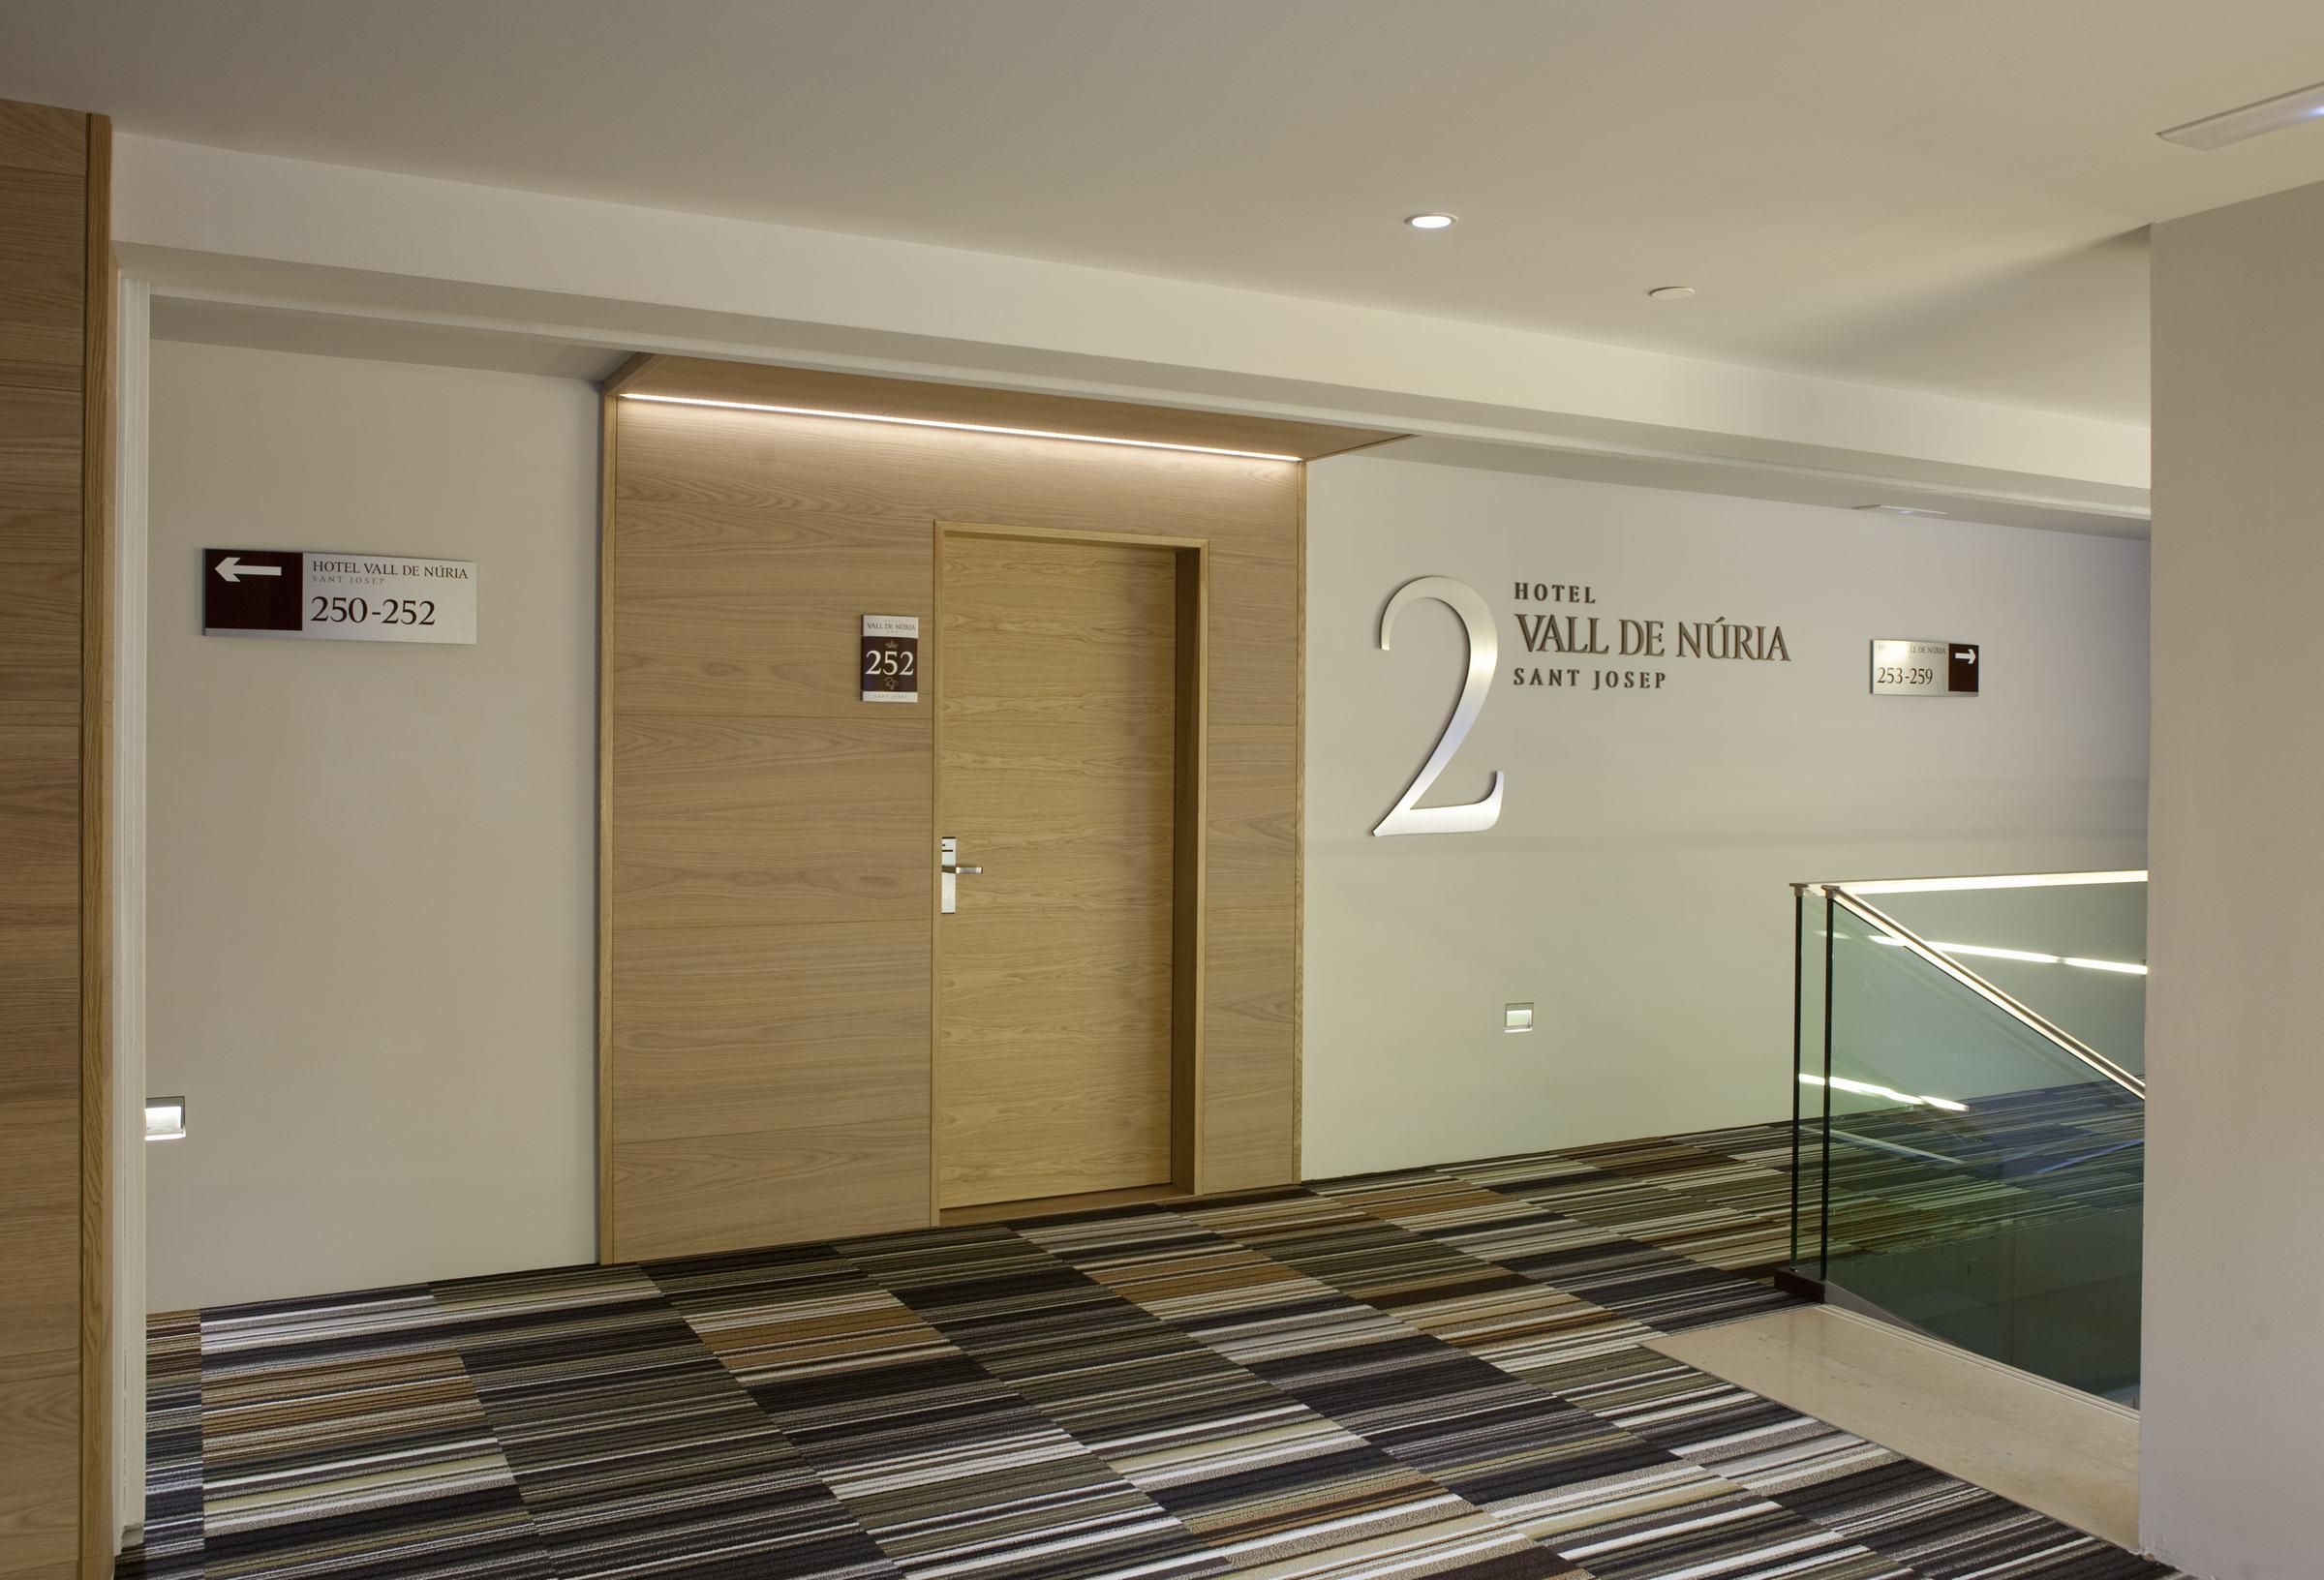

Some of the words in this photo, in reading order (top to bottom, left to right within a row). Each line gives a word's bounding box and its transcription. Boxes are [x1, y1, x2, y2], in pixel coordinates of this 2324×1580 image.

[313, 561, 360, 574] HOTEL
[363, 562, 399, 576] VALL
[402, 564, 420, 577] DE
[424, 565, 469, 579] NÚRIA
[350, 576, 385, 585] JOSEP
[1514, 581, 1596, 604] HOTEL
[310, 595, 436, 625] 250-252
[1514, 613, 1609, 654] VALL
[1618, 619, 1666, 657] DE
[1675, 616, 1791, 661] NÚRIA
[1918, 646, 1926, 654] DE
[865, 650, 914, 676] 252
[1513, 667, 1580, 686] SANT
[1592, 670, 1667, 690] JOSEP
[1877, 667, 1934, 685] 253-259
[1371, 574, 1505, 837] 2
